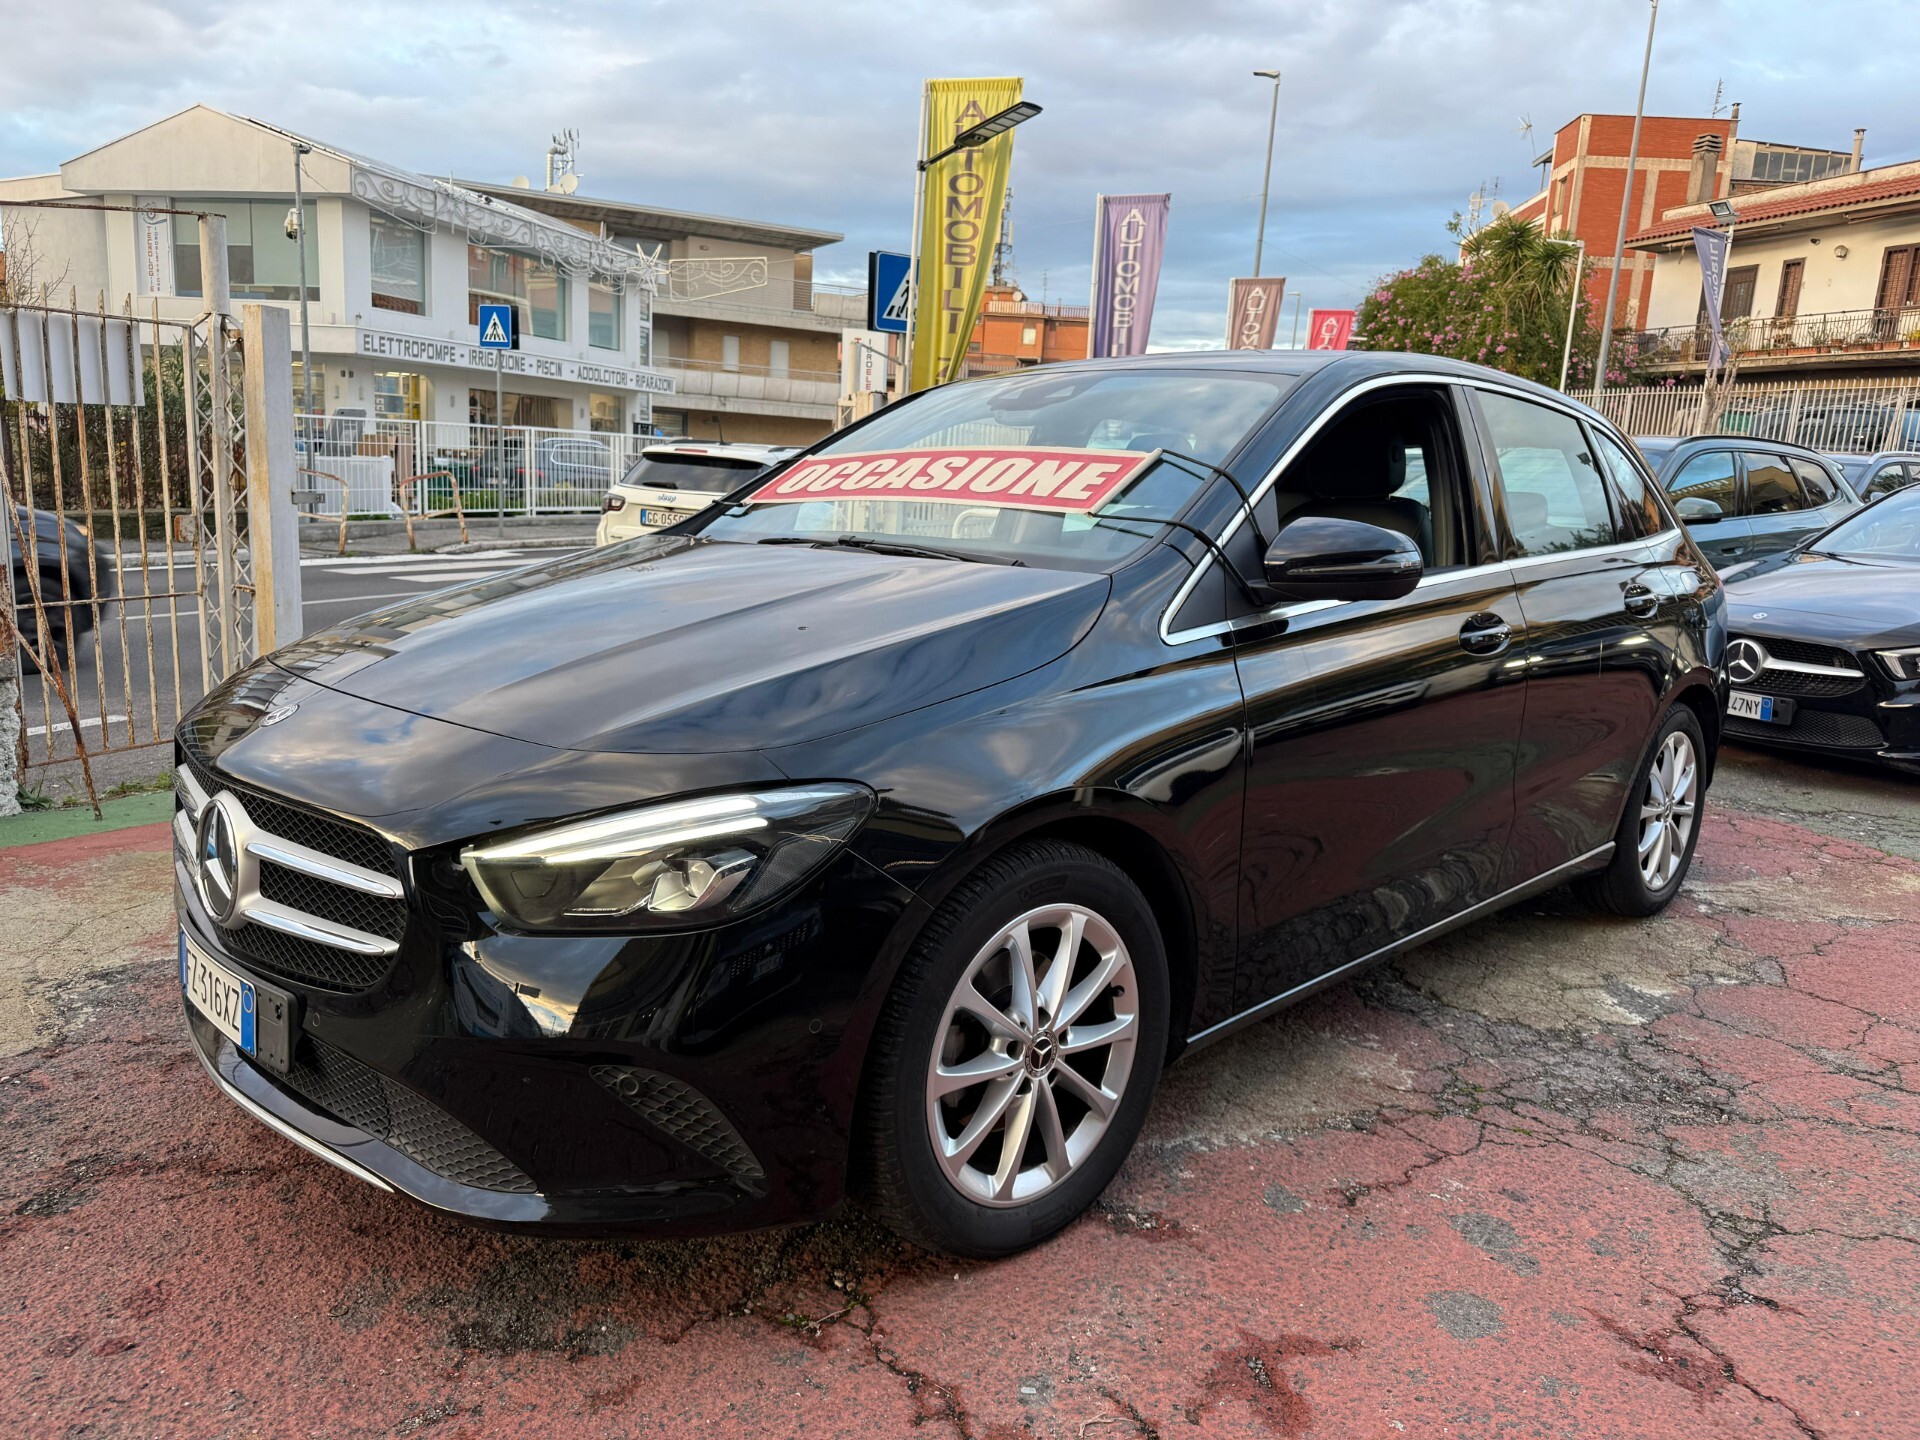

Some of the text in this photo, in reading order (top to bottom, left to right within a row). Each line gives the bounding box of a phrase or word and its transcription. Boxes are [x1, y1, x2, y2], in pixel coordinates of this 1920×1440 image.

[146, 225, 155, 292] TECNOLOGIE
[363, 333, 456, 363] ELETTROPOMPE
[577, 365, 628, 386] ADDOLCITORI
[635, 374, 674, 393] RIPARAZIONI
[775, 456, 1122, 501] OCCASIONE
